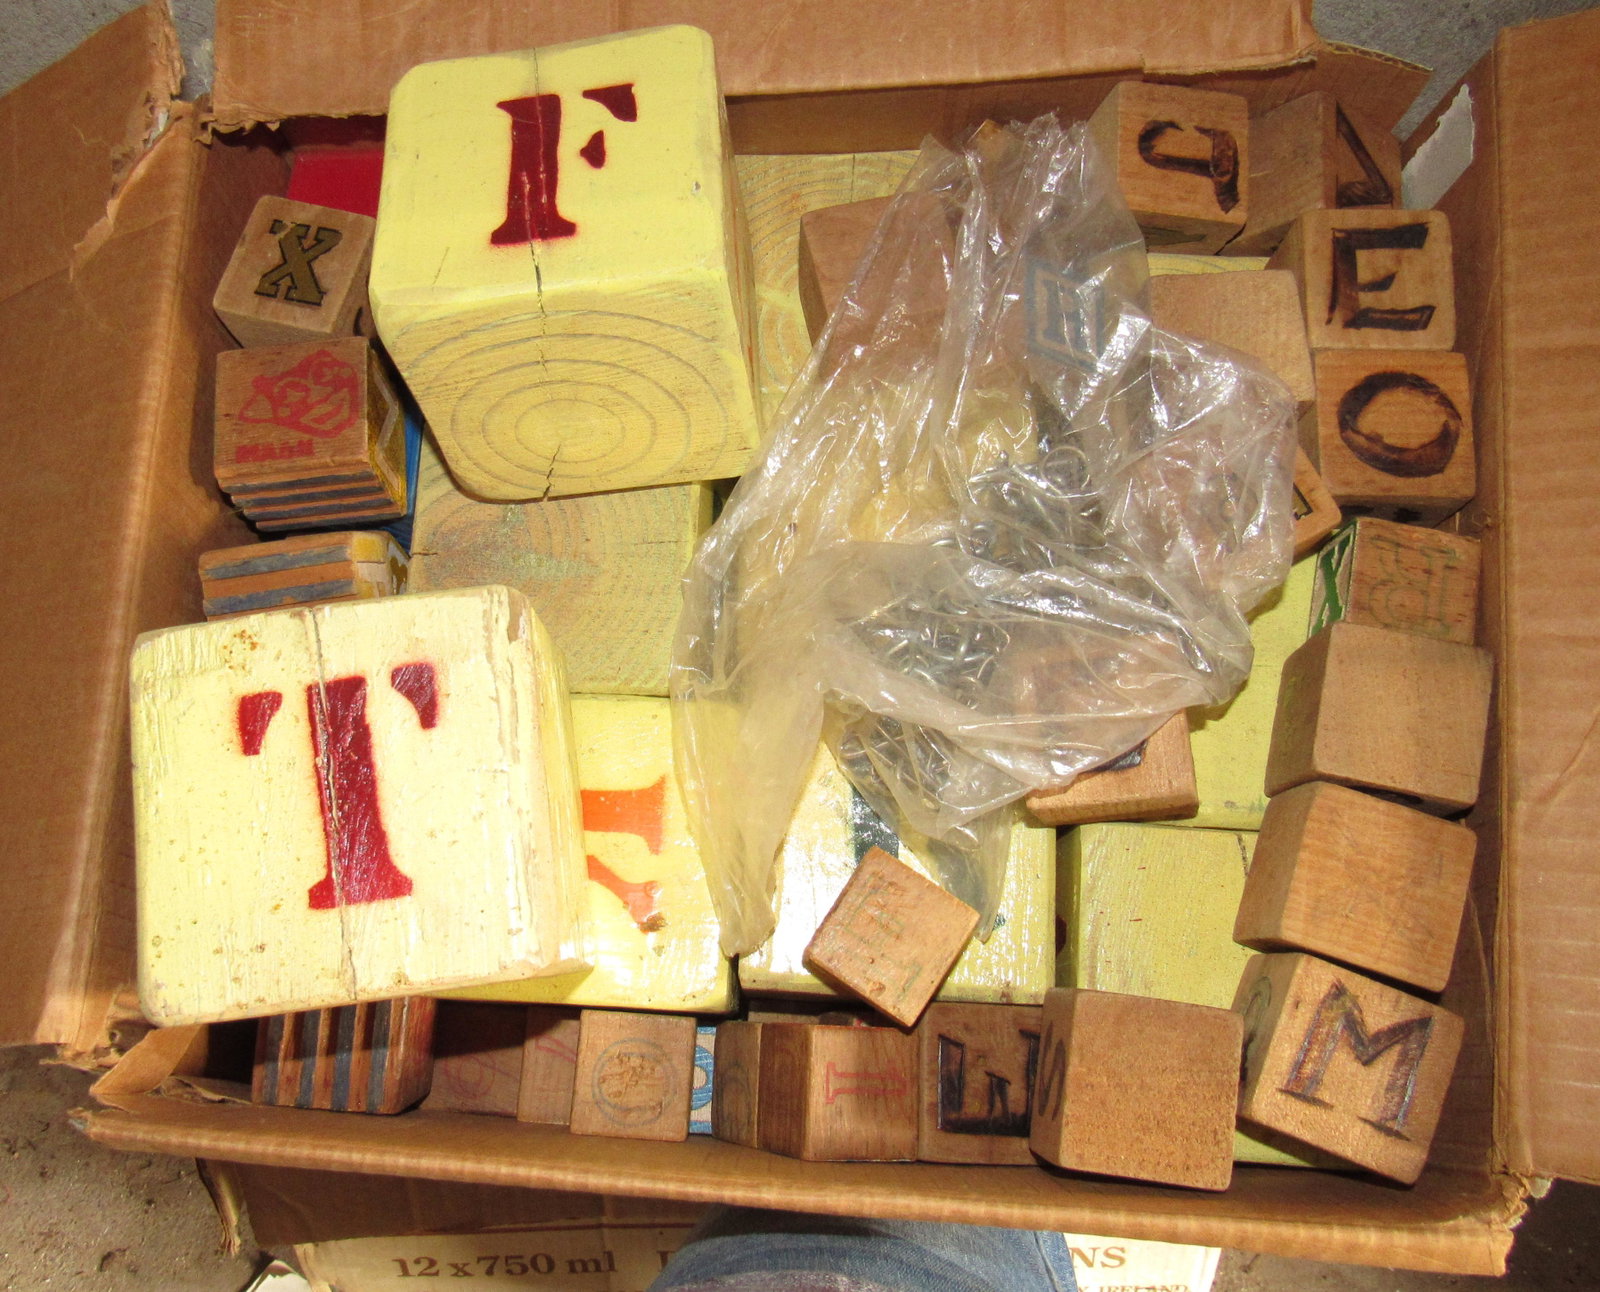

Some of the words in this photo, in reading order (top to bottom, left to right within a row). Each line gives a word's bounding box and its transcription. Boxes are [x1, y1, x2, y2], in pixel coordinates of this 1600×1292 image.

[490, 82, 638, 246] F
[1138, 120, 1240, 214] J
[254, 219, 343, 307] X
[1326, 222, 1437, 331] E
[1337, 371, 1463, 478] O
[237, 661, 439, 912] T
[936, 1032, 1041, 1138] E
[1276, 975, 1433, 1142] M
